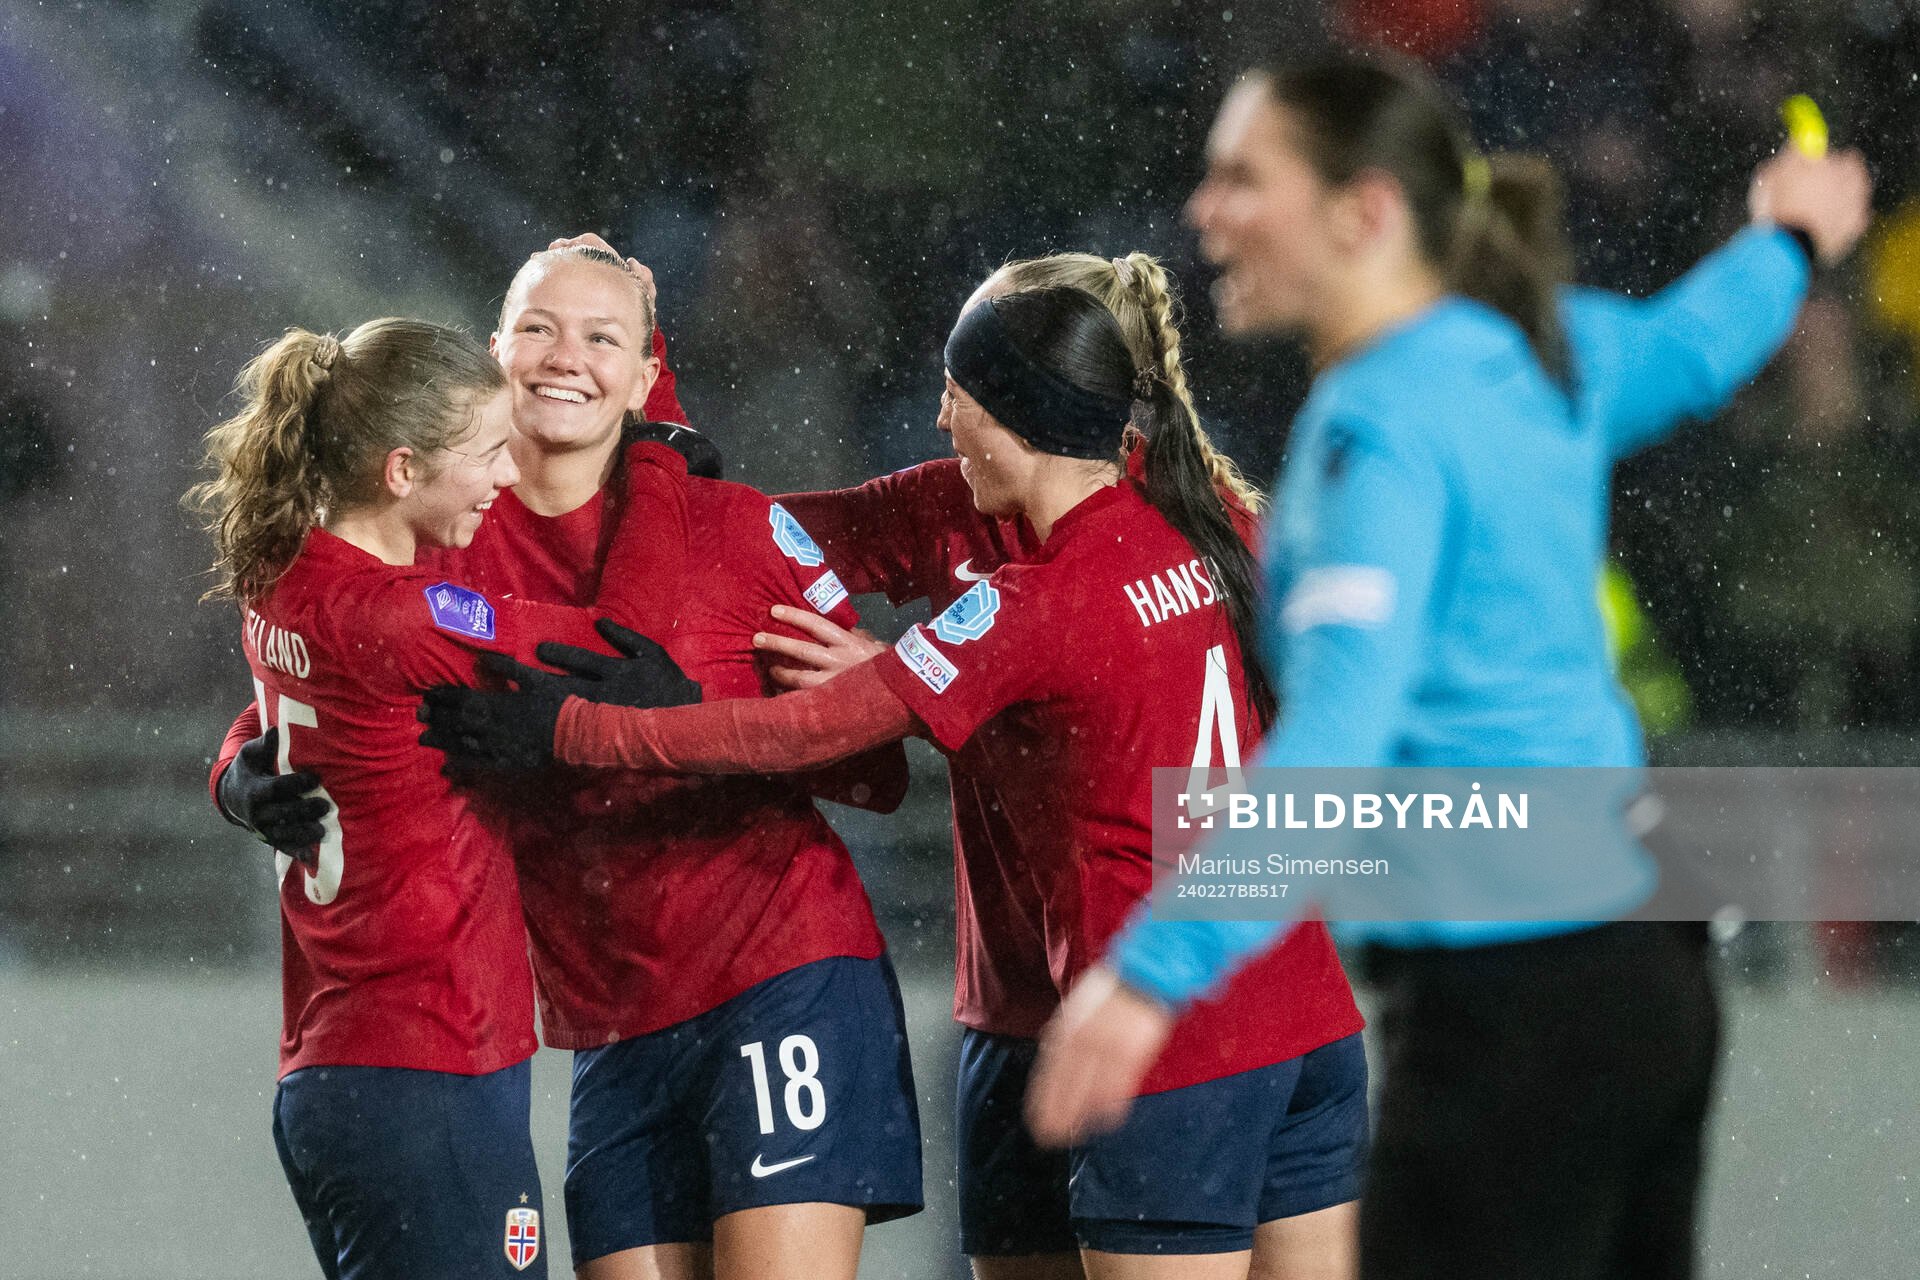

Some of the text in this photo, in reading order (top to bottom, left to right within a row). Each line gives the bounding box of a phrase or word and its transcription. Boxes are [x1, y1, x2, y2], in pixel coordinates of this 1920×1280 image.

[1123, 559, 1220, 627] HANS
[1185, 644, 1248, 819] 4
[740, 1034, 827, 1135] 18
